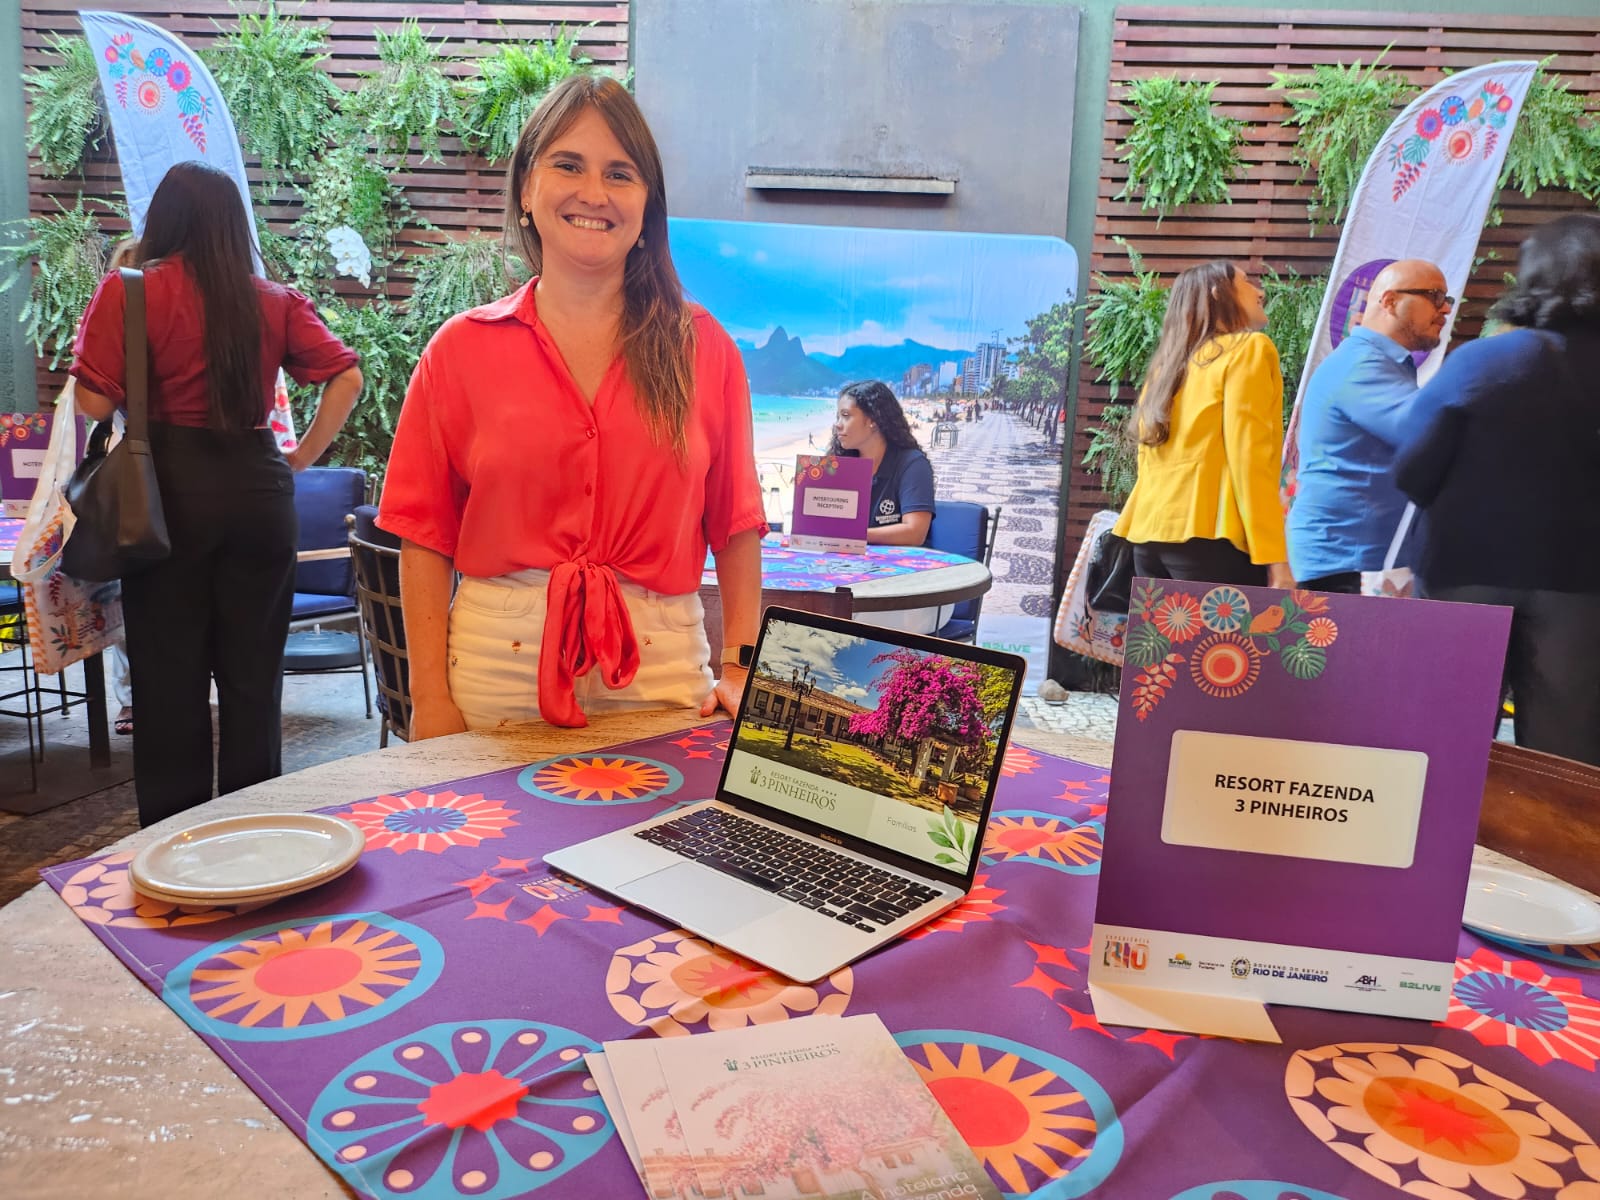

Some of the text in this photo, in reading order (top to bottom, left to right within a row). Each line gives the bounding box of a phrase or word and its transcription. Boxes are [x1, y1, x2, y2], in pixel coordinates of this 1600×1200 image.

[792, 778, 819, 792] FAZENDA
[1215, 774, 1375, 803] RESORT FAZENDA
[759, 778, 837, 812] 3 PINHEIROS
[1234, 799, 1348, 823] 3 PINHEIROS
[1253, 962, 1287, 970] GOVERNO
[1253, 967, 1328, 983] RIO DE JANEIRO
[1354, 975, 1377, 987] ABH
[1399, 980, 1442, 992] B2LIVE
[742, 1047, 841, 1071] 3 PINHEIROS
